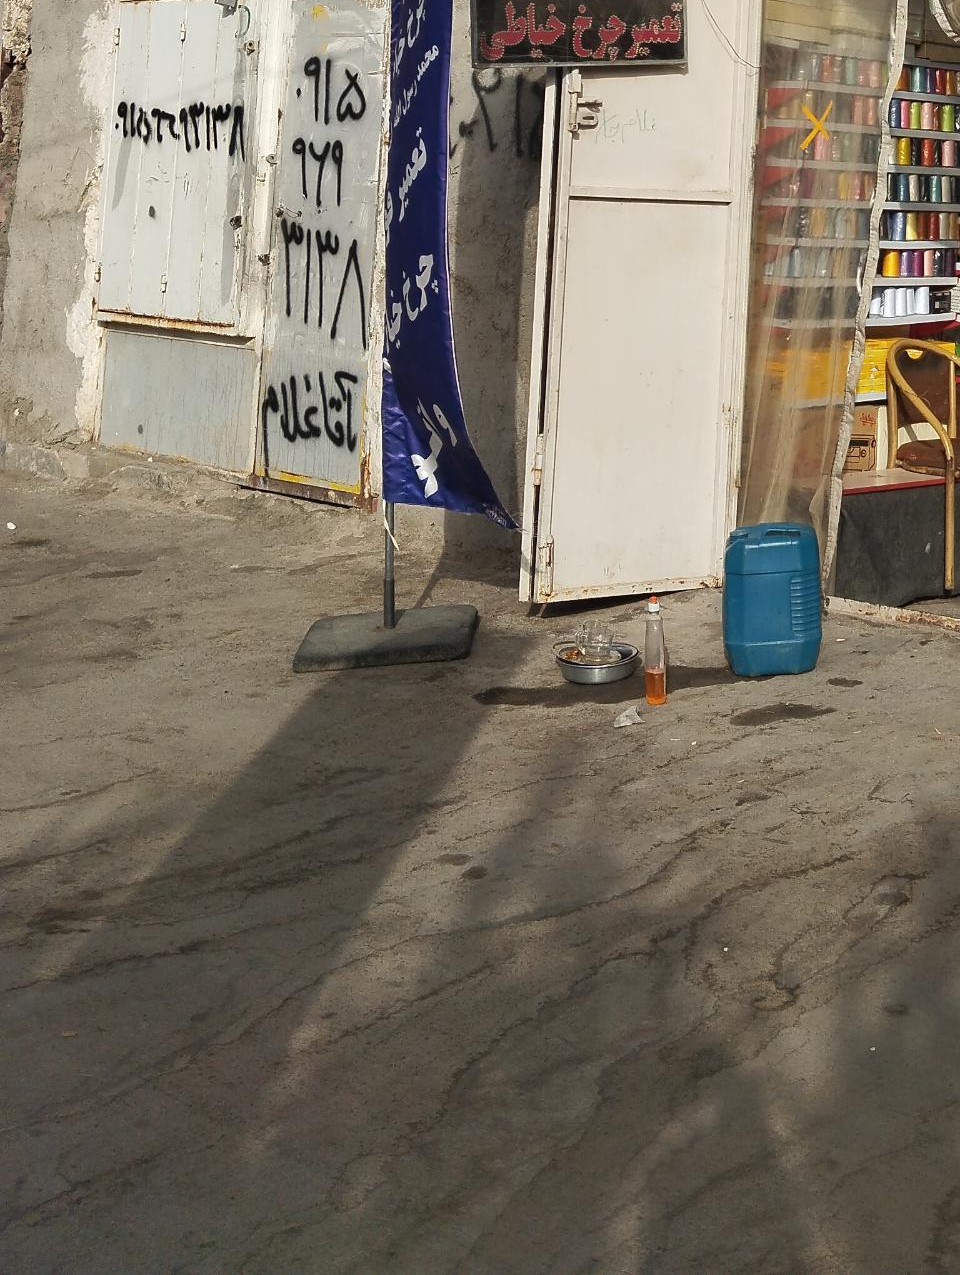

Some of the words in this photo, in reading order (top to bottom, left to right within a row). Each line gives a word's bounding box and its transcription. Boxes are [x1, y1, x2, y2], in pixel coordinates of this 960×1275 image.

[479, 0, 566, 61] خیاطی
[571, 4, 627, 61] چرخ
[625, 2, 683, 59] تعمیر
[296, 56, 366, 126] ۰۹۱۵
[417, 44, 439, 82] محمد
[398, 126, 427, 222] تعمیر
[279, 217, 368, 350] ۳۱۳۸
[403, 254, 439, 322] چرخ
